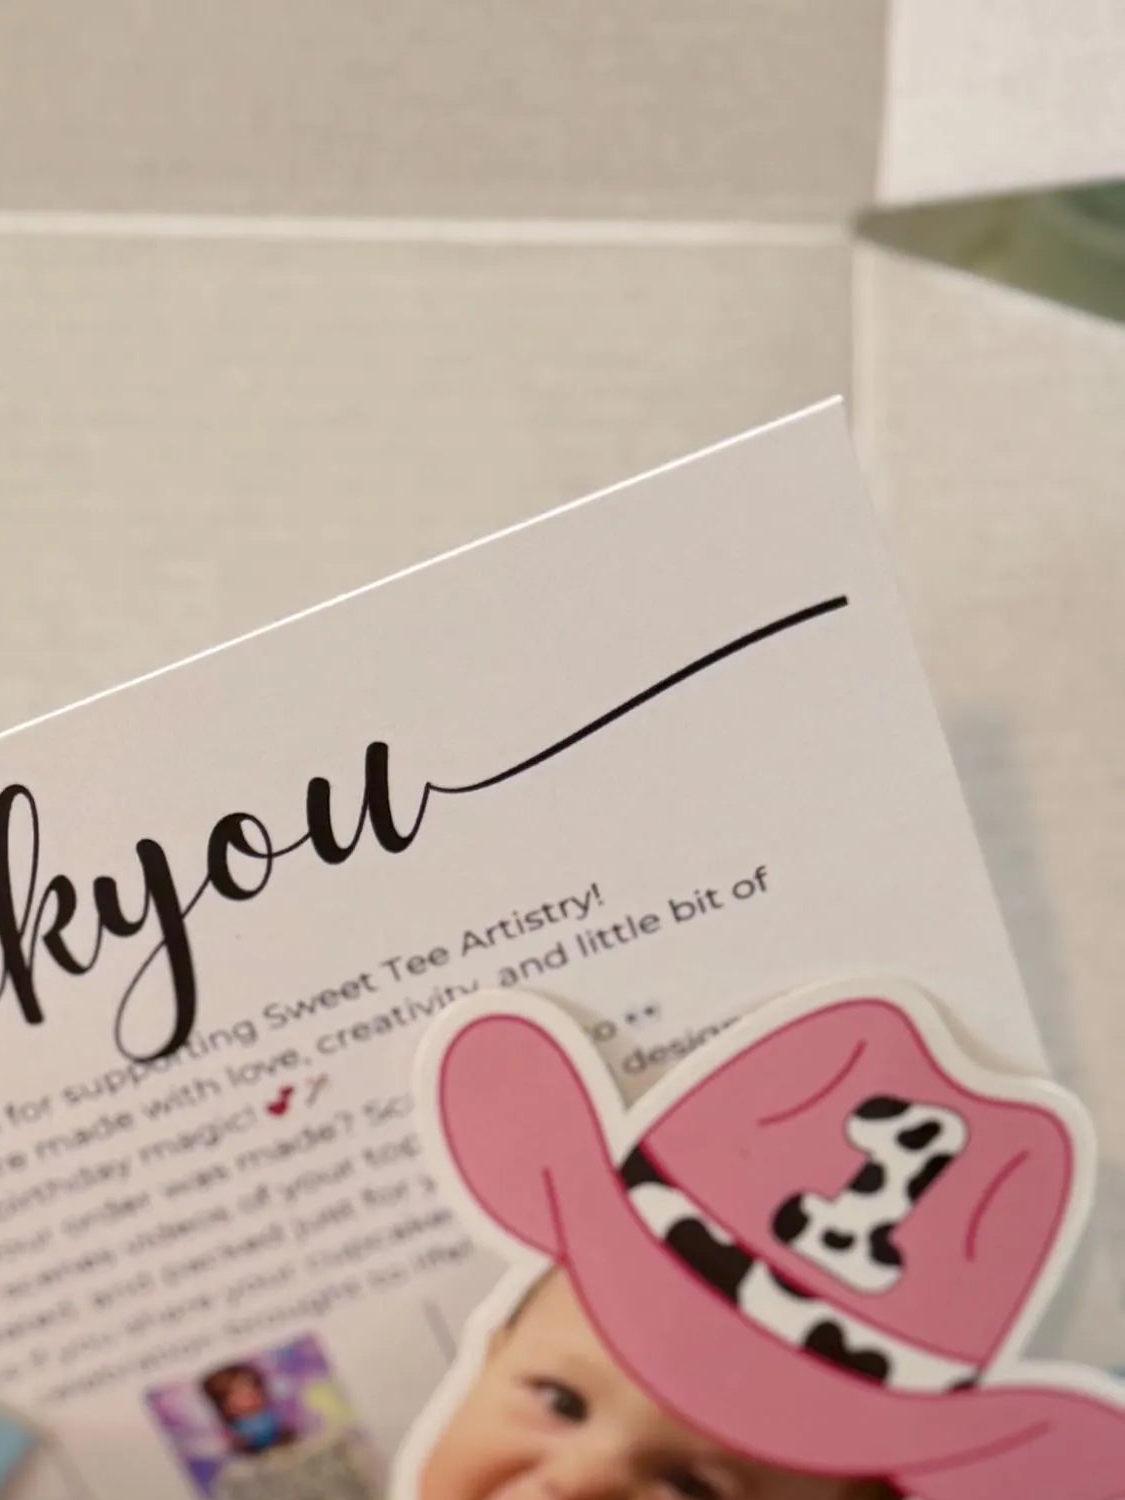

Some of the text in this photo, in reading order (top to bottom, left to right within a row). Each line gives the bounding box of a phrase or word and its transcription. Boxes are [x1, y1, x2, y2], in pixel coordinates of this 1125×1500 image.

[2, 1094, 53, 1129] for
[261, 972, 379, 1030] Sweet
[380, 946, 450, 983] Tee
[461, 882, 605, 958] Artistry!
[34, 1110, 136, 1160] made
[140, 1077, 223, 1121] with
[224, 1047, 313, 1089] love,
[498, 940, 570, 989] and
[575, 913, 661, 958] little
[667, 888, 724, 924] bit
[731, 864, 768, 901] of
